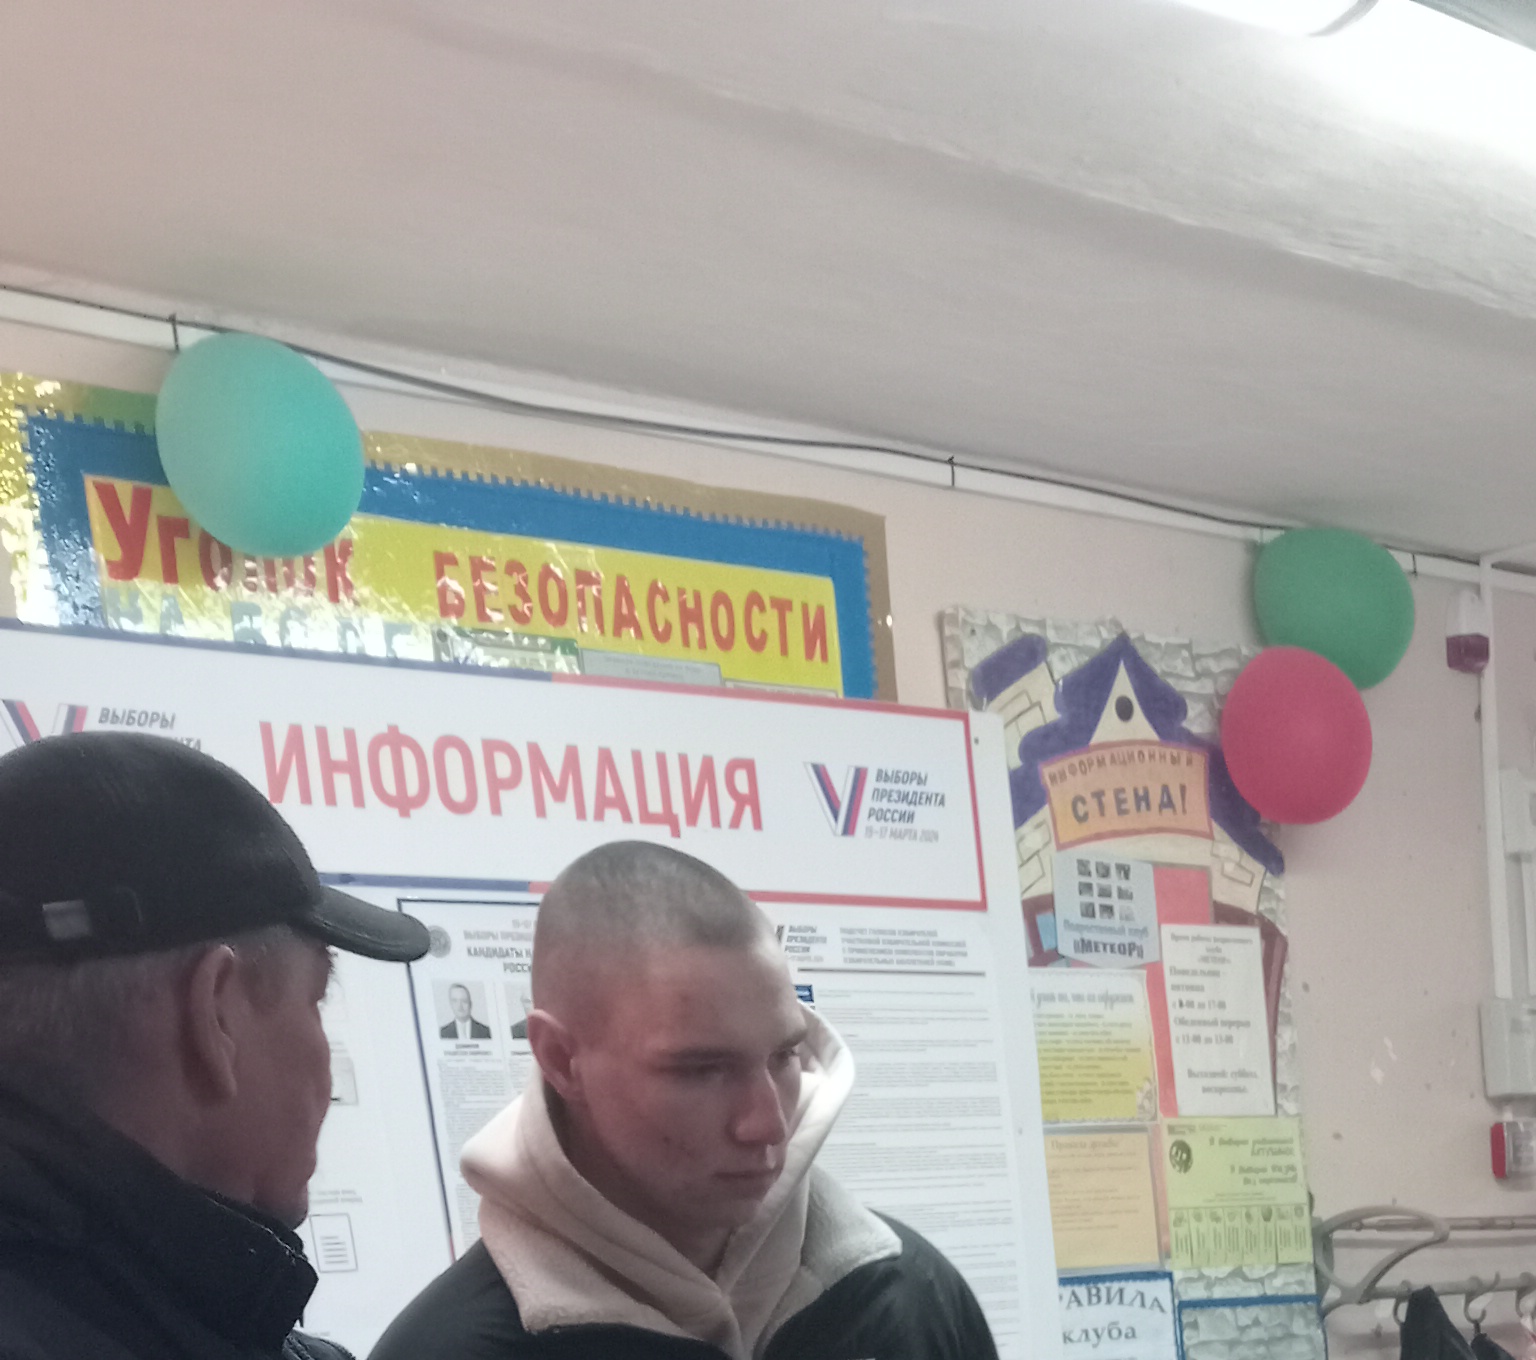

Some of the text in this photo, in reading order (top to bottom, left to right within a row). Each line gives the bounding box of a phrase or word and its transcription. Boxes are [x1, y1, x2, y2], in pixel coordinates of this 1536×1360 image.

[433, 551, 829, 663] БЕЗОПАСНОСТИ
[98, 707, 176, 730] ВЫБОРЫ
[259, 720, 763, 839] ИНФОРМАЦИЯ
[875, 768, 928, 786] ВЫБОРЫ
[1048, 750, 1193, 786] ИНФОРМАЦИОННЫЙ
[871, 787, 946, 808] ПРЕЗИДЕНТА
[1071, 783, 1187, 823] СТЕНД!
[867, 806, 916, 824] РОССИИ
[1058, 1285, 1167, 1314] АВИЛА
[1062, 1320, 1138, 1348] клуба
